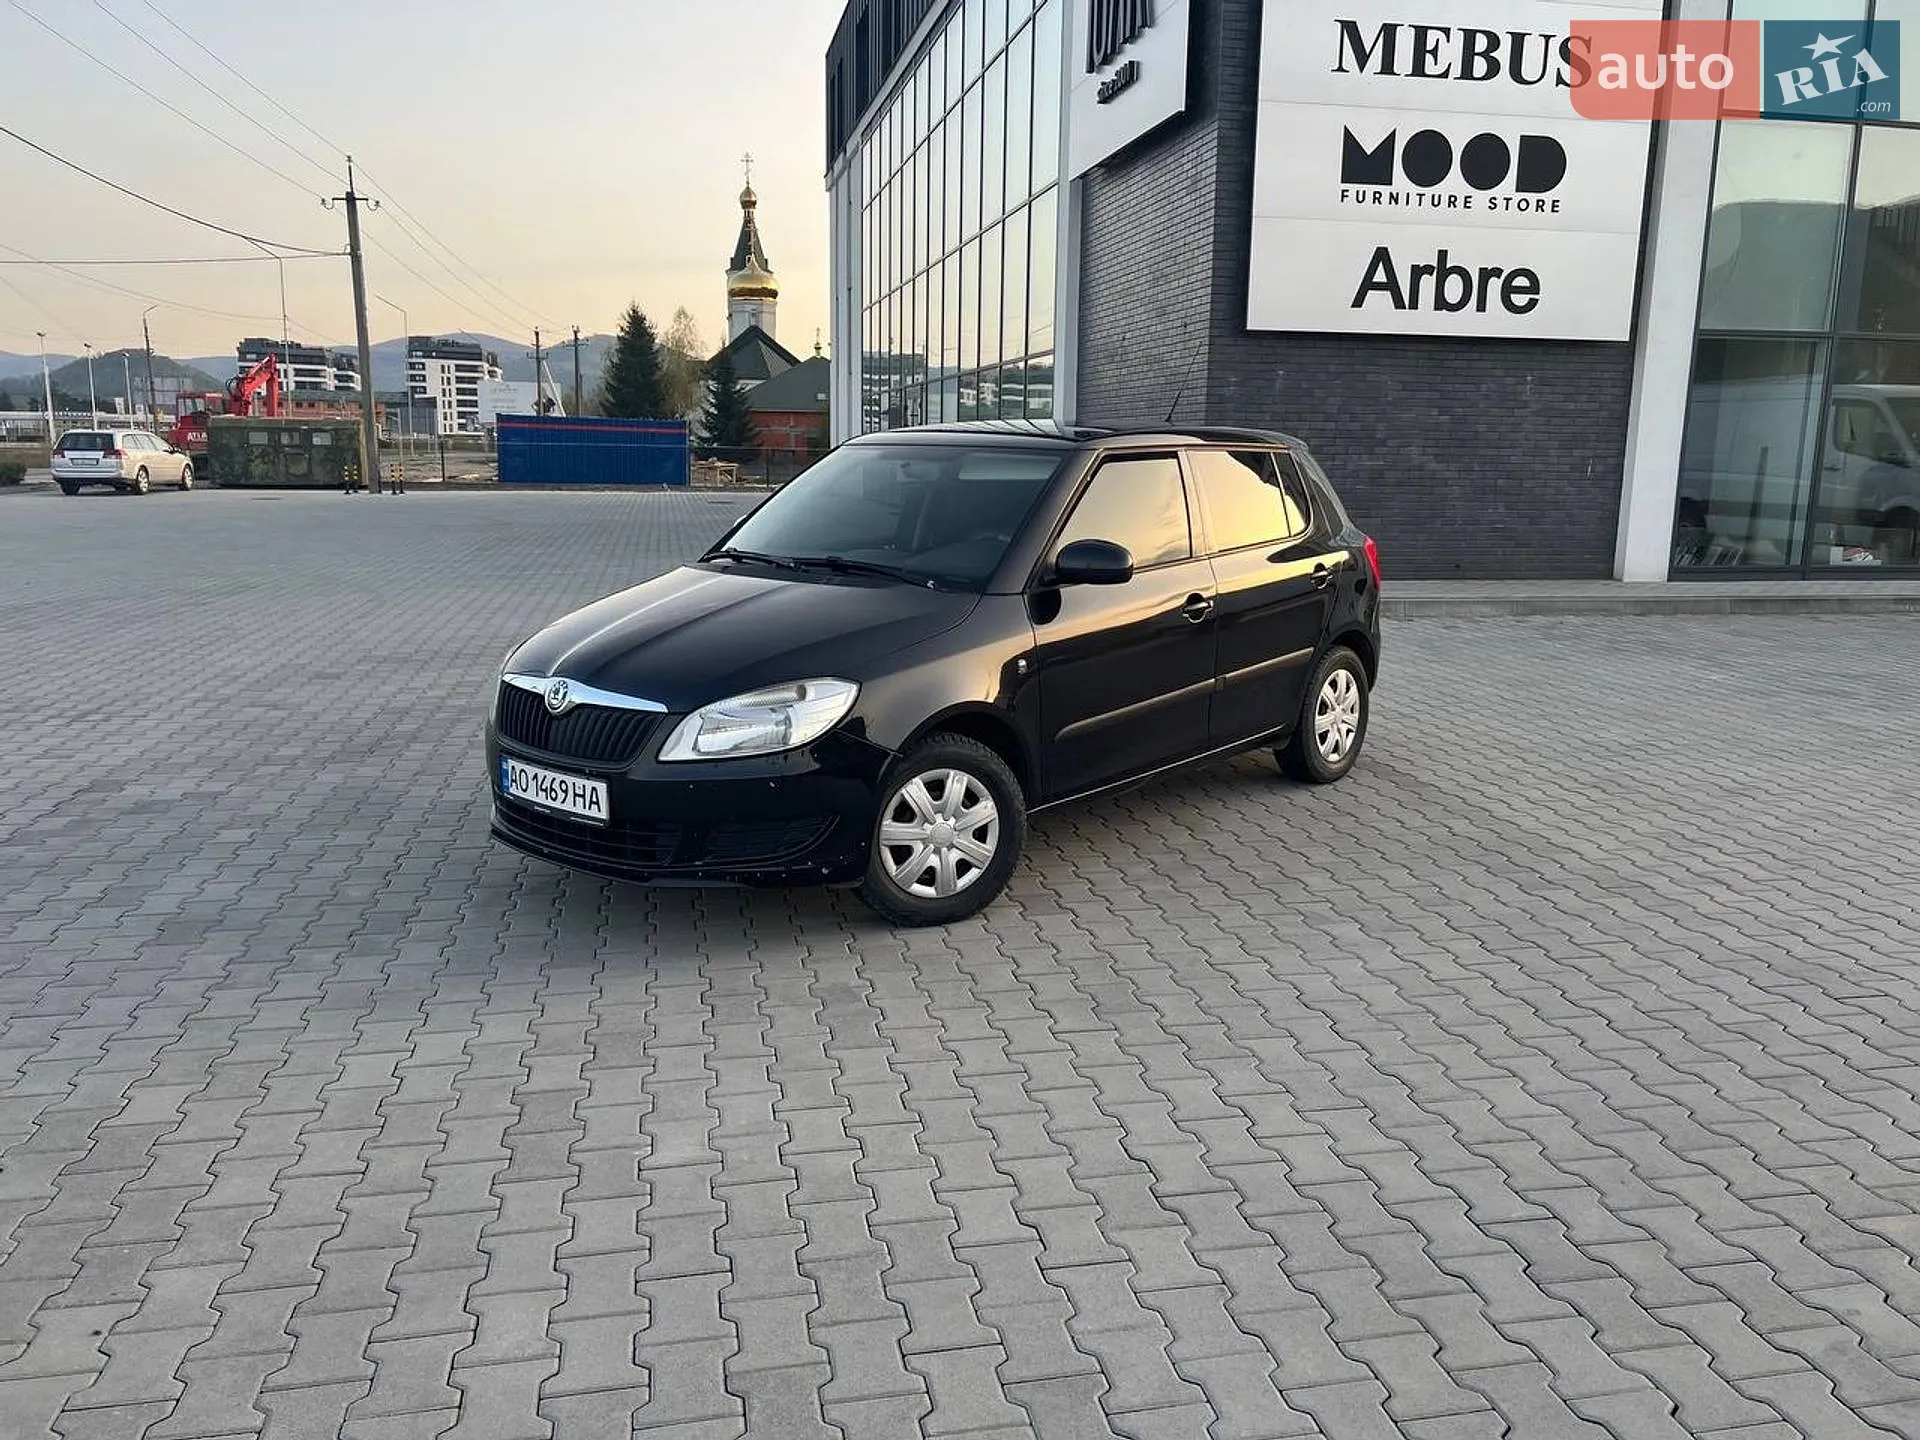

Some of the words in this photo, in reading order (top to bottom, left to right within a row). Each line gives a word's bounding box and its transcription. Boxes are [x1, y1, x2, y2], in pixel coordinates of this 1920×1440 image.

[1331, 19, 1593, 88] MEBUS
[1340, 124, 1567, 193] MOOD
[1340, 189, 1473, 209] FURNITURE
[1487, 196, 1560, 213] STORE
[1350, 246, 1540, 315] Arbre
[187, 431, 208, 441] ATLA
